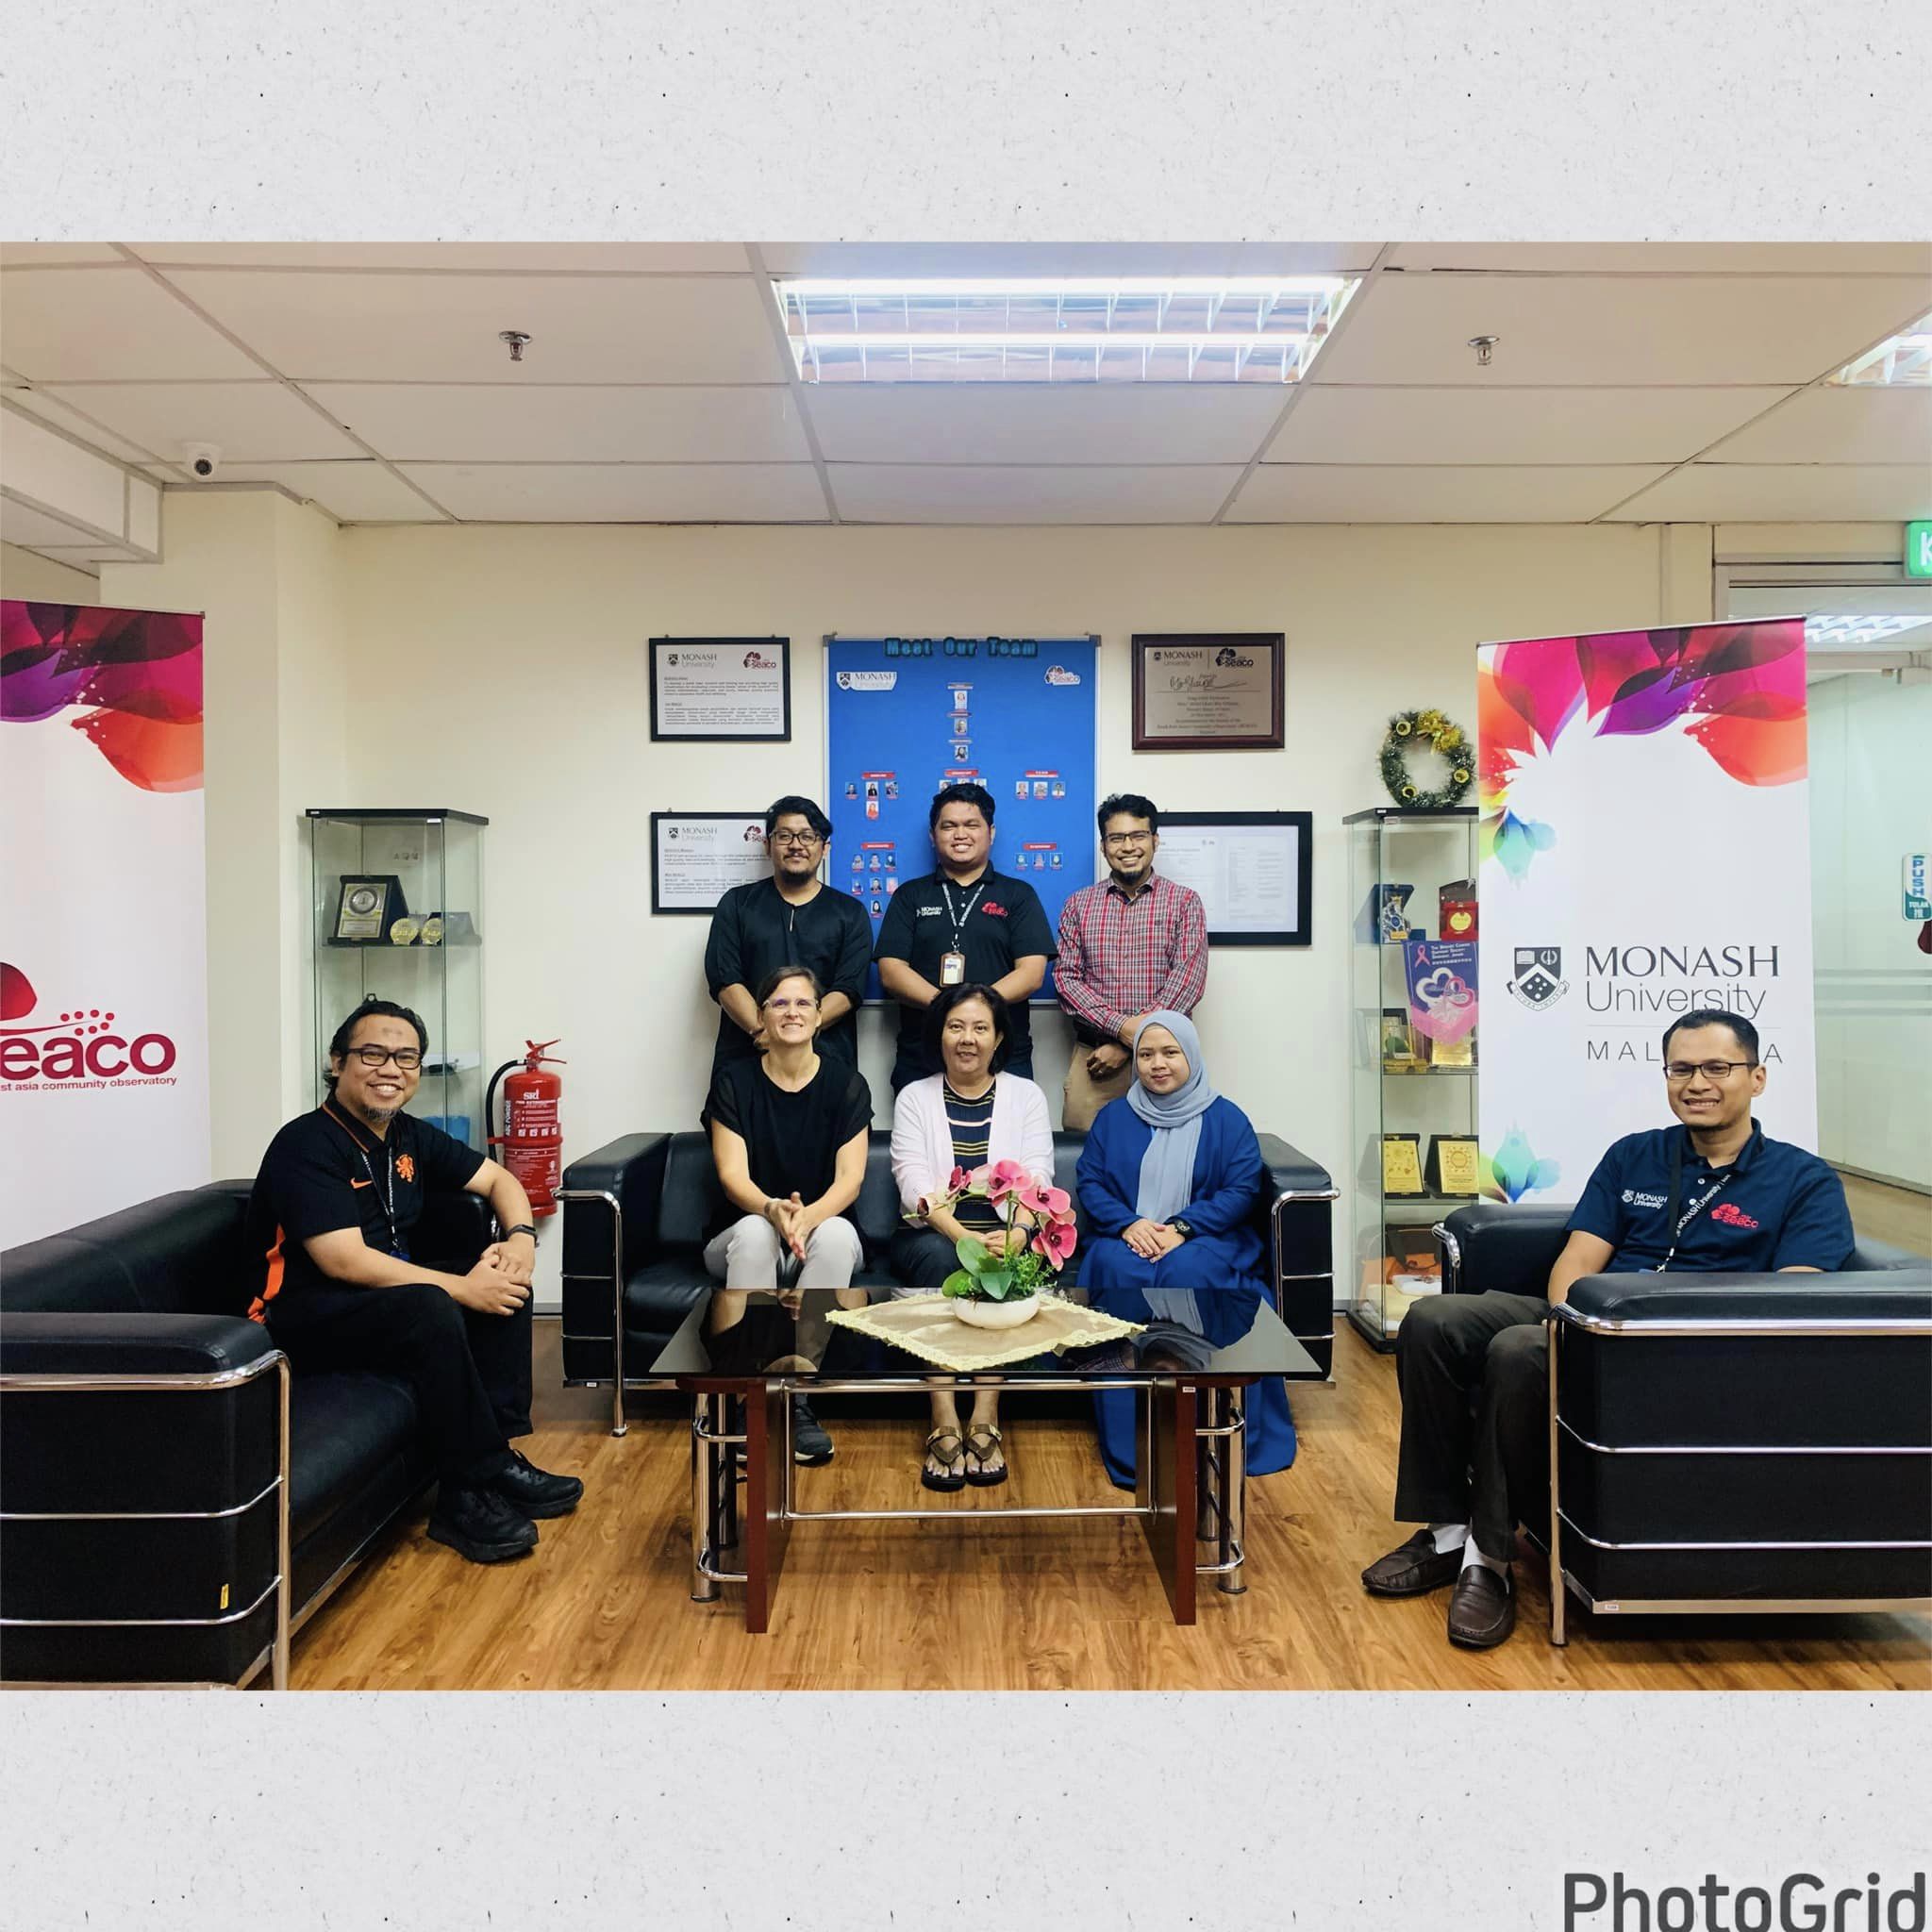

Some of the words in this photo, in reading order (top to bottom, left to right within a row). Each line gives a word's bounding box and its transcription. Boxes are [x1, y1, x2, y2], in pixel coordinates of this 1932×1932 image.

[885, 638, 932, 657] Meet
[944, 637, 977, 657] Our
[988, 637, 1038, 658] Team
[1163, 650, 1203, 659] MONASH
[681, 653, 717, 661] MONASH
[681, 826, 717, 835] MONASH
[1912, 859, 1924, 896] PUSH
[1586, 945, 1780, 977] MONASH
[1587, 981, 1767, 1020] University
[1588, 1041, 1783, 1064] MALA
[15, 1081, 39, 1091] asia
[42, 1079, 107, 1091] community
[110, 1076, 177, 1088] observatory
[1633, 1199, 1664, 1209] University
[1635, 1191, 1668, 1204] MONASH
[1676, 1203, 1702, 1230] MONASH
